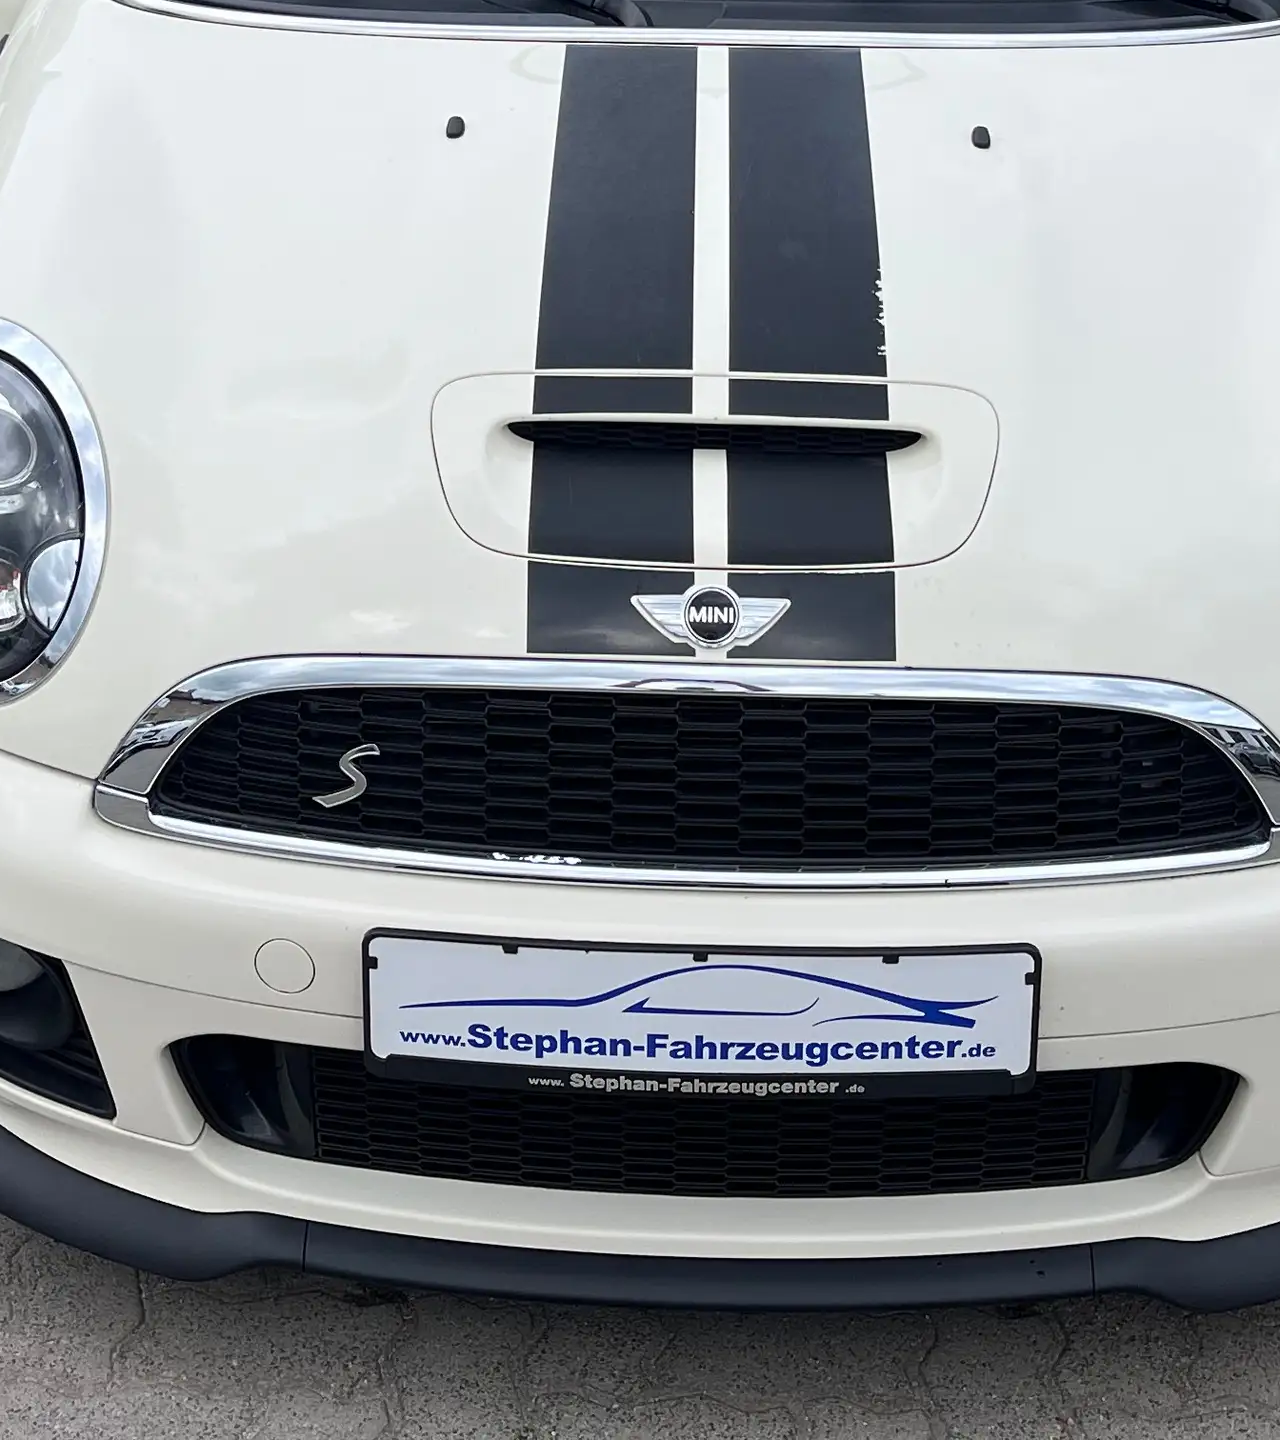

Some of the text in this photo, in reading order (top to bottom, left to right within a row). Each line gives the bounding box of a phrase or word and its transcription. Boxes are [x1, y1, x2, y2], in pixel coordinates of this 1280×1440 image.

[688, 606, 735, 624] MINI
[312, 743, 381, 808] S
[399, 1023, 997, 1067] www.Stephan-Fahrzeugcenter.de
